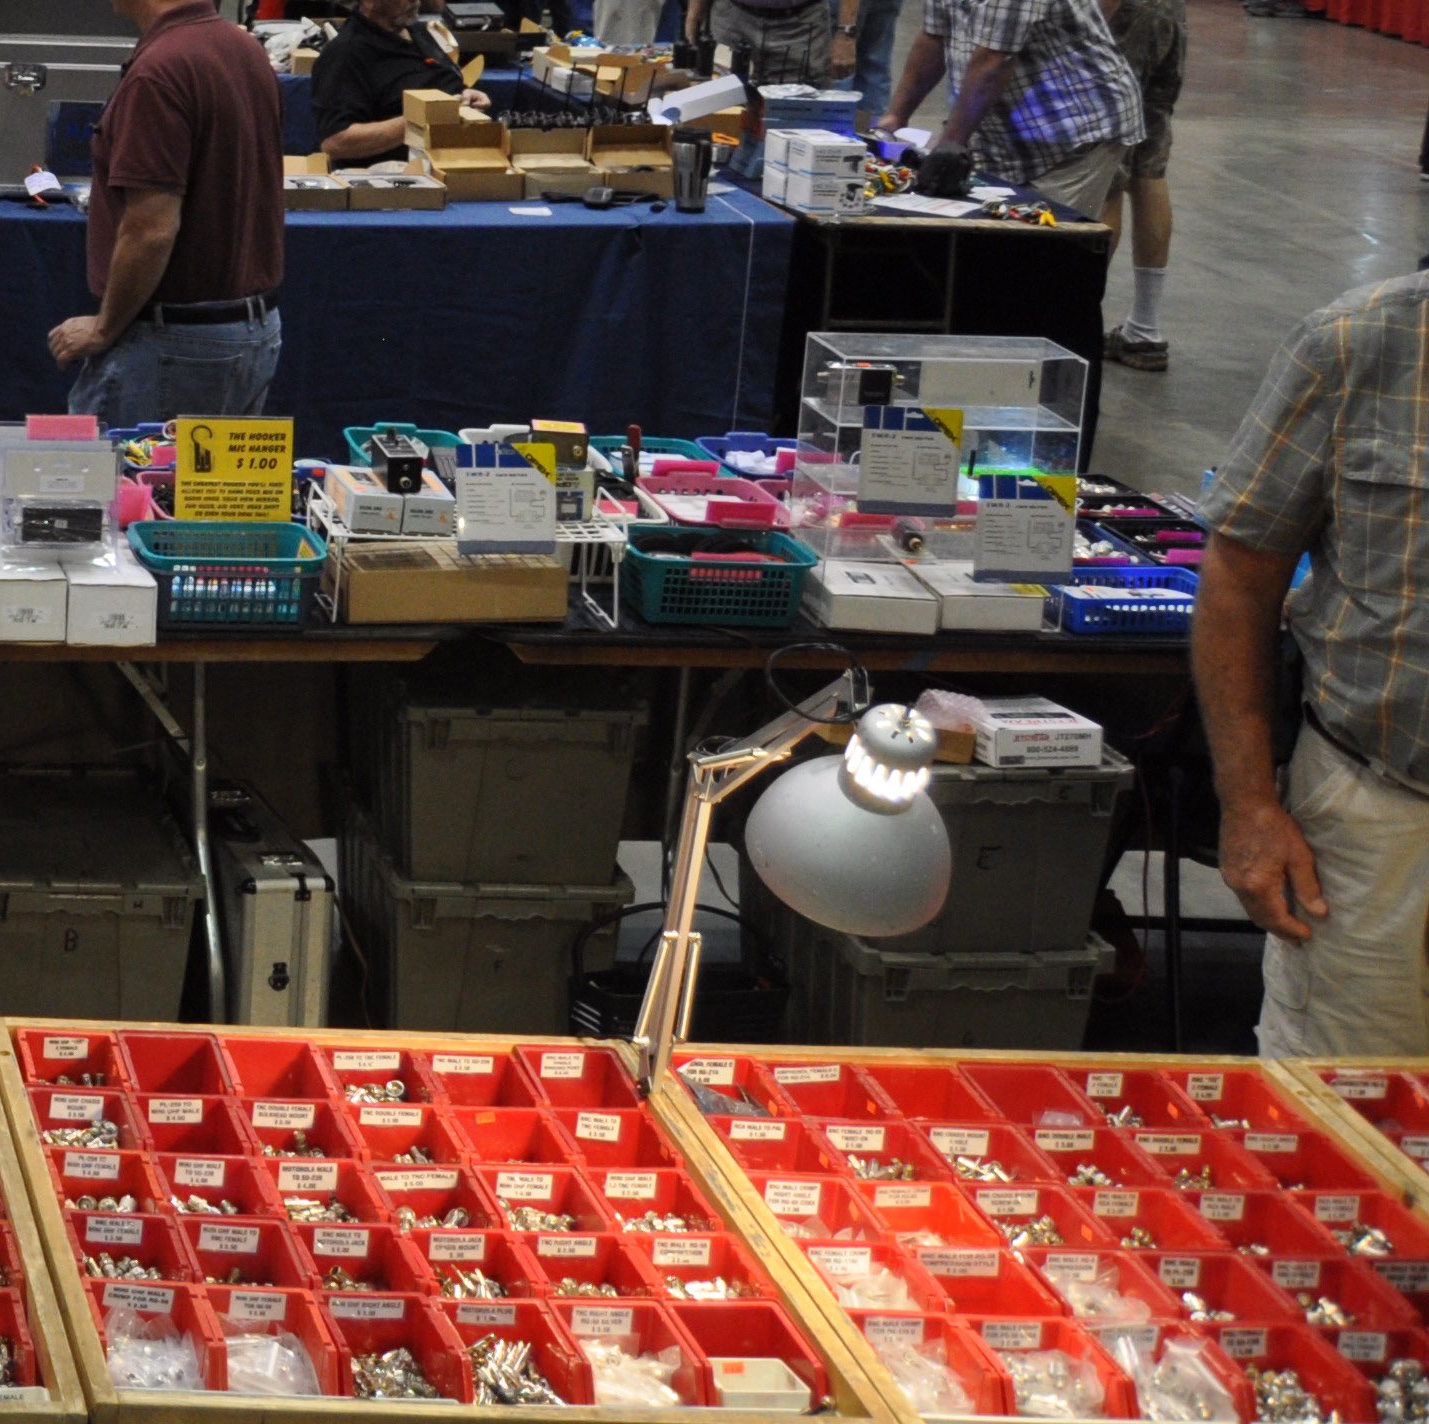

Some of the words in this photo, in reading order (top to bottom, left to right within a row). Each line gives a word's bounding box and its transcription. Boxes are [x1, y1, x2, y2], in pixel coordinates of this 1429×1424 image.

[229, 432, 246, 441] THE
[249, 433, 286, 441] HOOKER
[249, 445, 286, 453] HANGER
